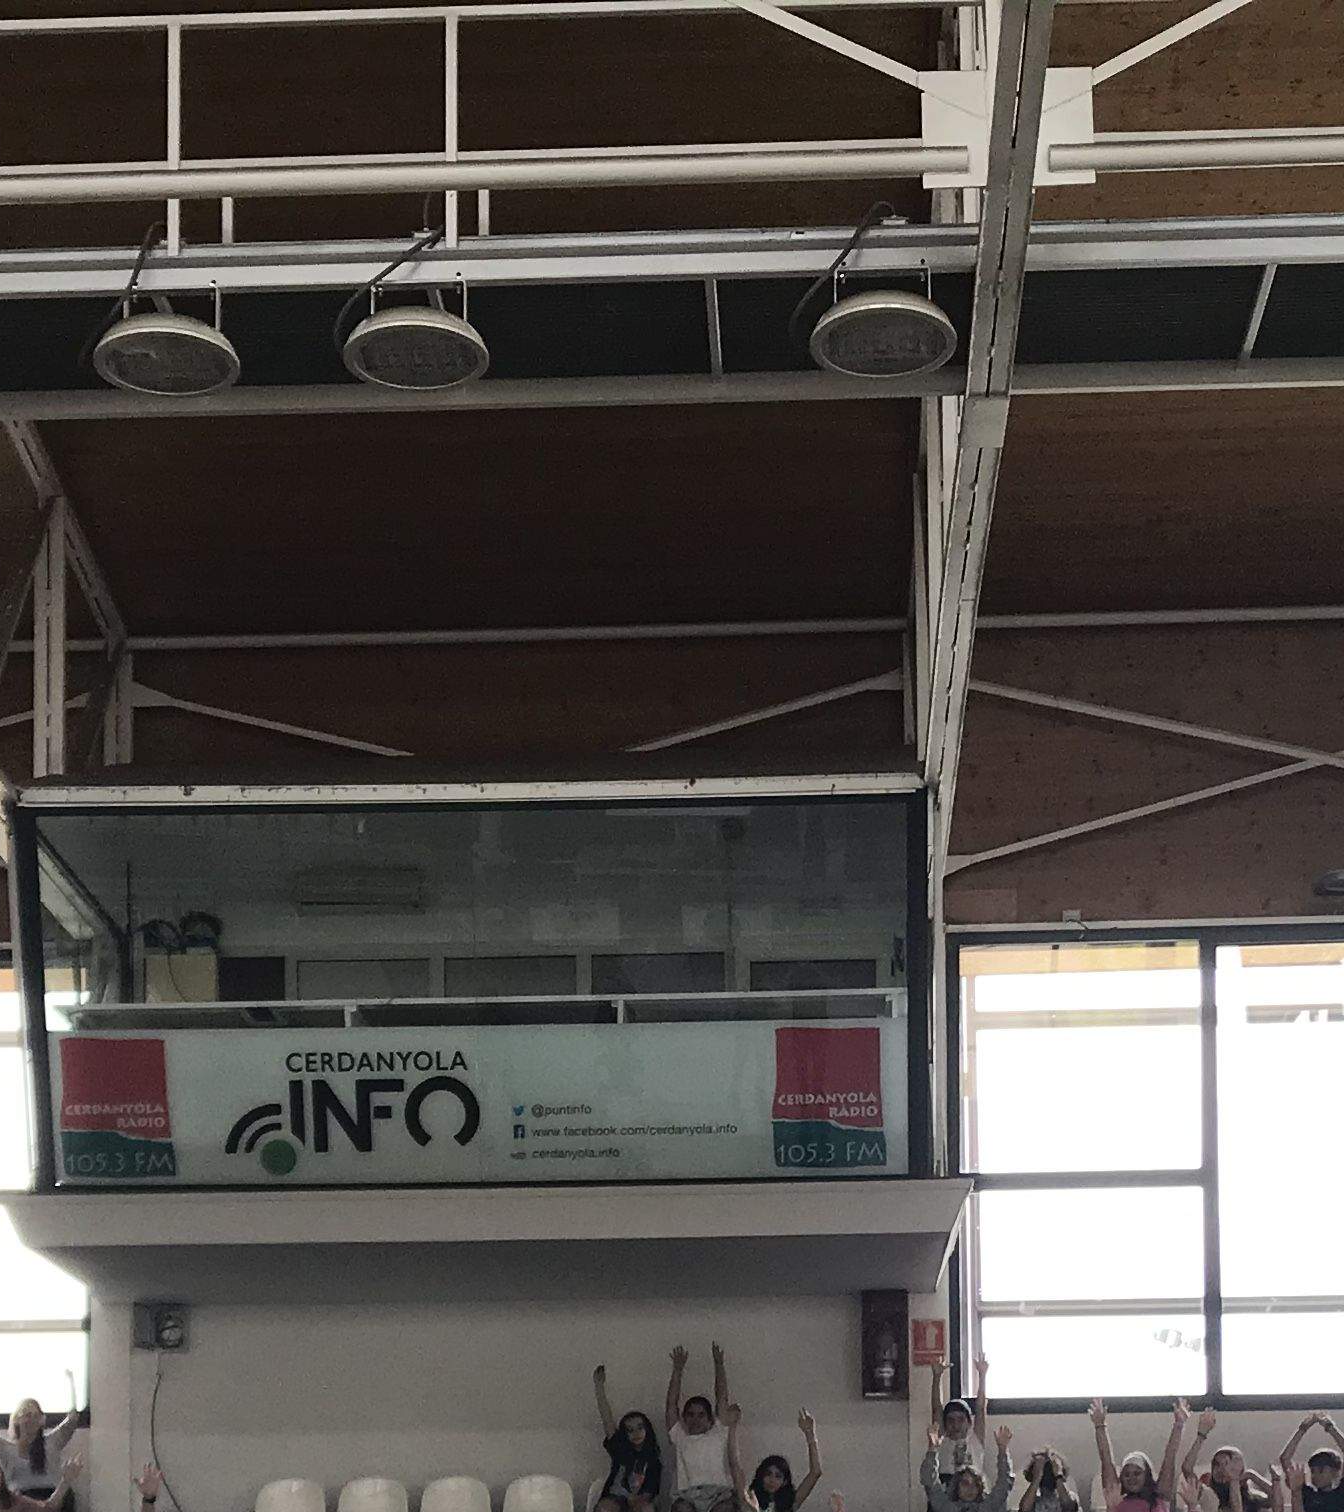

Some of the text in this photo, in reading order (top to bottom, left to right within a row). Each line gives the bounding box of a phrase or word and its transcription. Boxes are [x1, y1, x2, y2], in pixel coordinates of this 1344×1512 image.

[285, 1051, 468, 1072] CERDANYOLA
[778, 1092, 877, 1106] CERDANYOLA
[64, 1102, 164, 1116] CERDANYOLA
[289, 1075, 481, 1153] INFO
[531, 1103, 592, 1118] @puntinfo
[532, 1148, 620, 1161] cerdanyola.info
[777, 1142, 883, 1163] 105.3 FM
[66, 1152, 173, 1173] 105.3 FM
